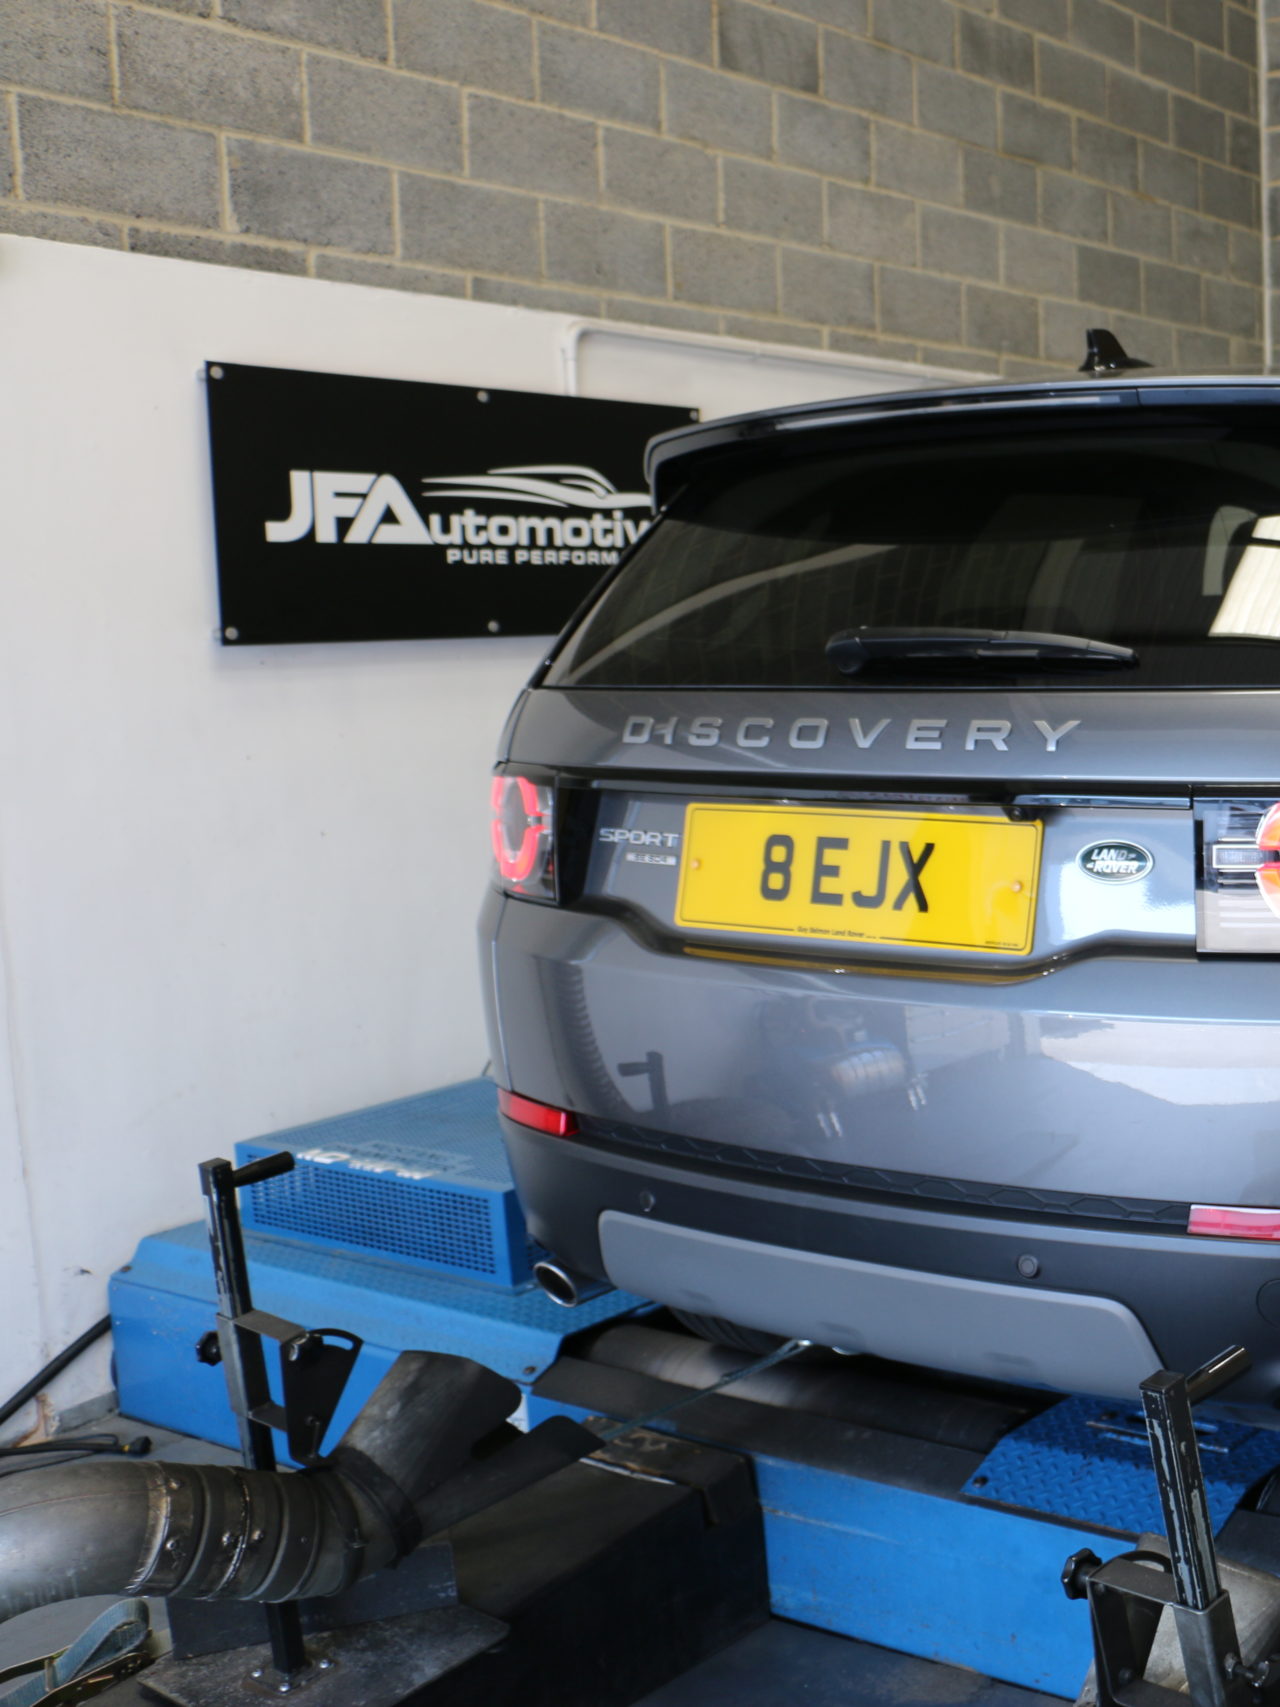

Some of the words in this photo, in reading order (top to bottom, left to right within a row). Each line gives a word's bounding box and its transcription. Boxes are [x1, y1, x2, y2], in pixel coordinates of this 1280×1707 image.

[264, 469, 651, 547] JFAutomotiv
[446, 549, 508, 564] PURE
[515, 550, 621, 566] PERFORM
[622, 715, 1081, 752] DISCOVERY
[599, 828, 679, 848] SPORT
[1091, 848, 1128, 861] LAND
[760, 834, 795, 902] 8
[810, 836, 936, 913] EJX
[1092, 860, 1139, 874] ROVER
